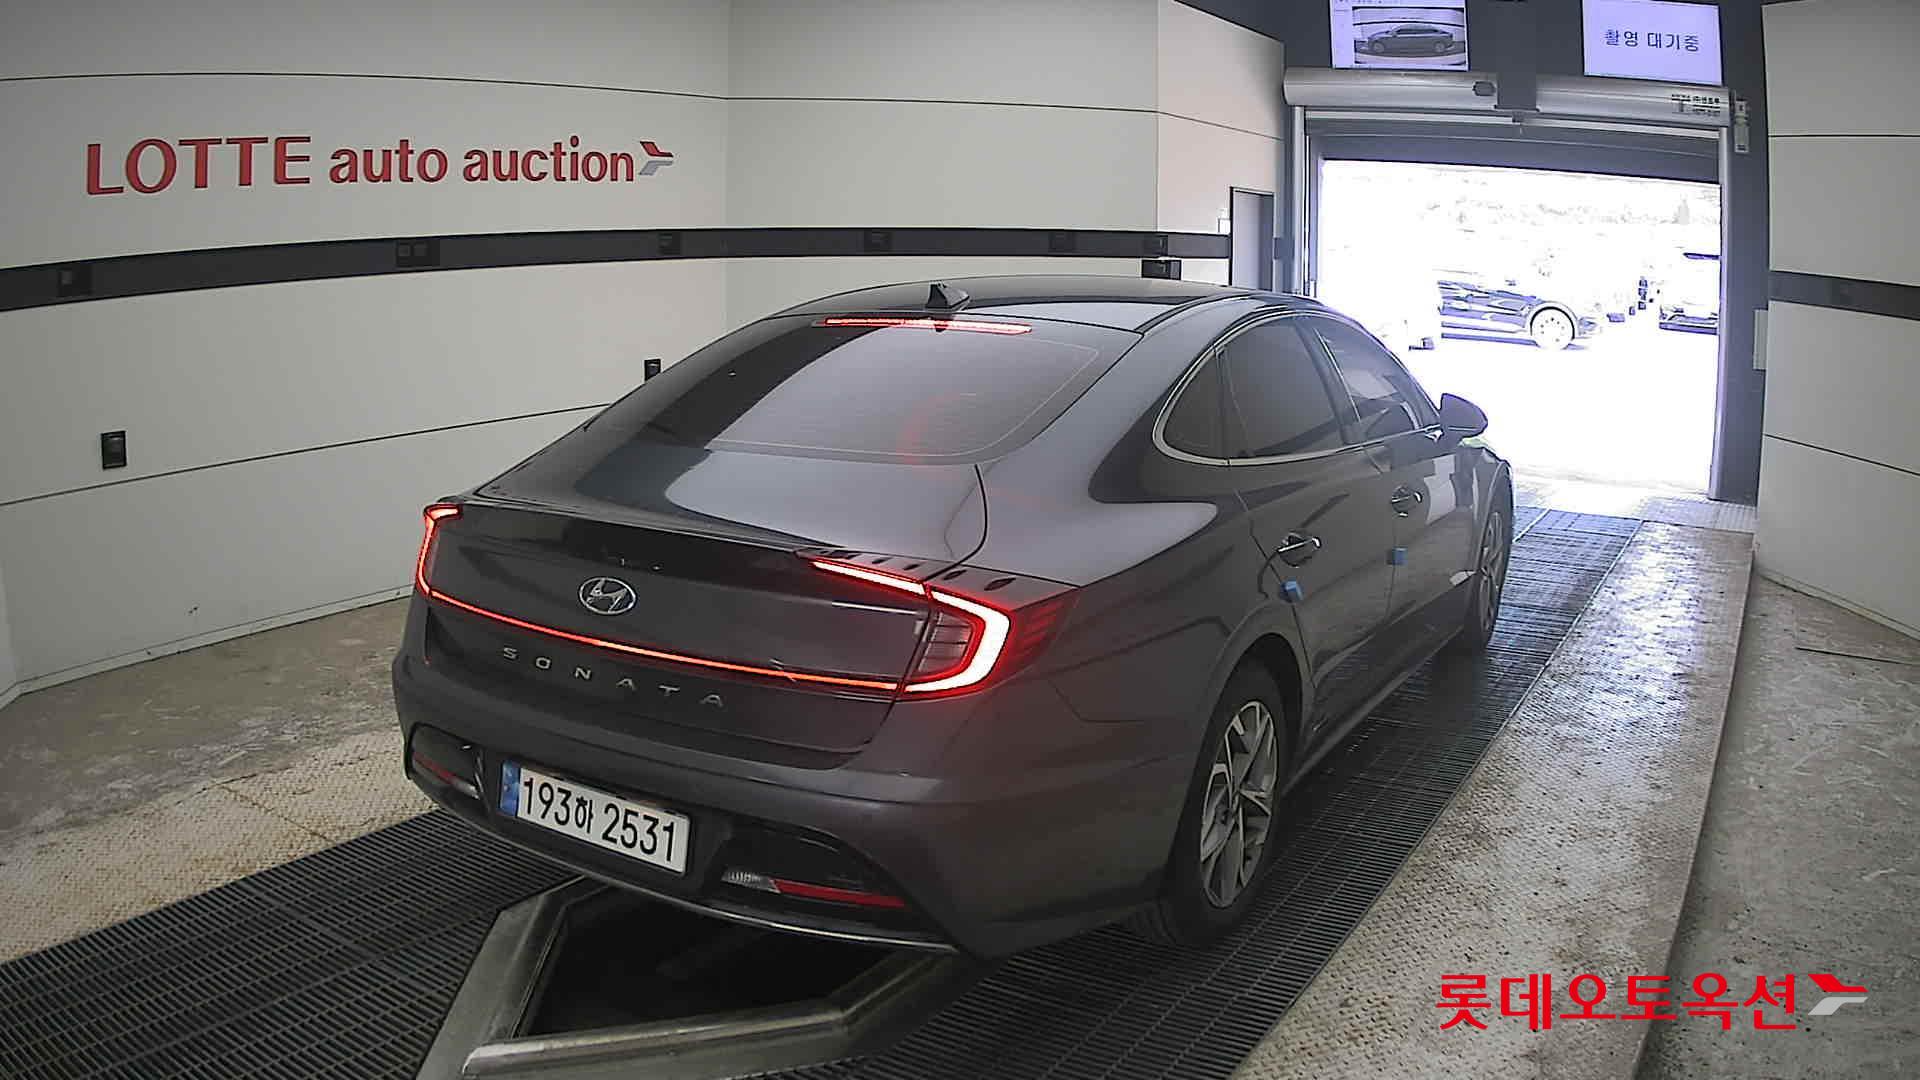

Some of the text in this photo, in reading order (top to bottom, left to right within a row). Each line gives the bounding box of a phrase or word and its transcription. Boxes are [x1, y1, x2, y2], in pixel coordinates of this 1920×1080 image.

[1647, 32, 1698, 51] 대기중
[86, 136, 634, 195] LOTTE auto auction
[502, 647, 724, 707] SONATA
[523, 777, 675, 862] 193하 2531
